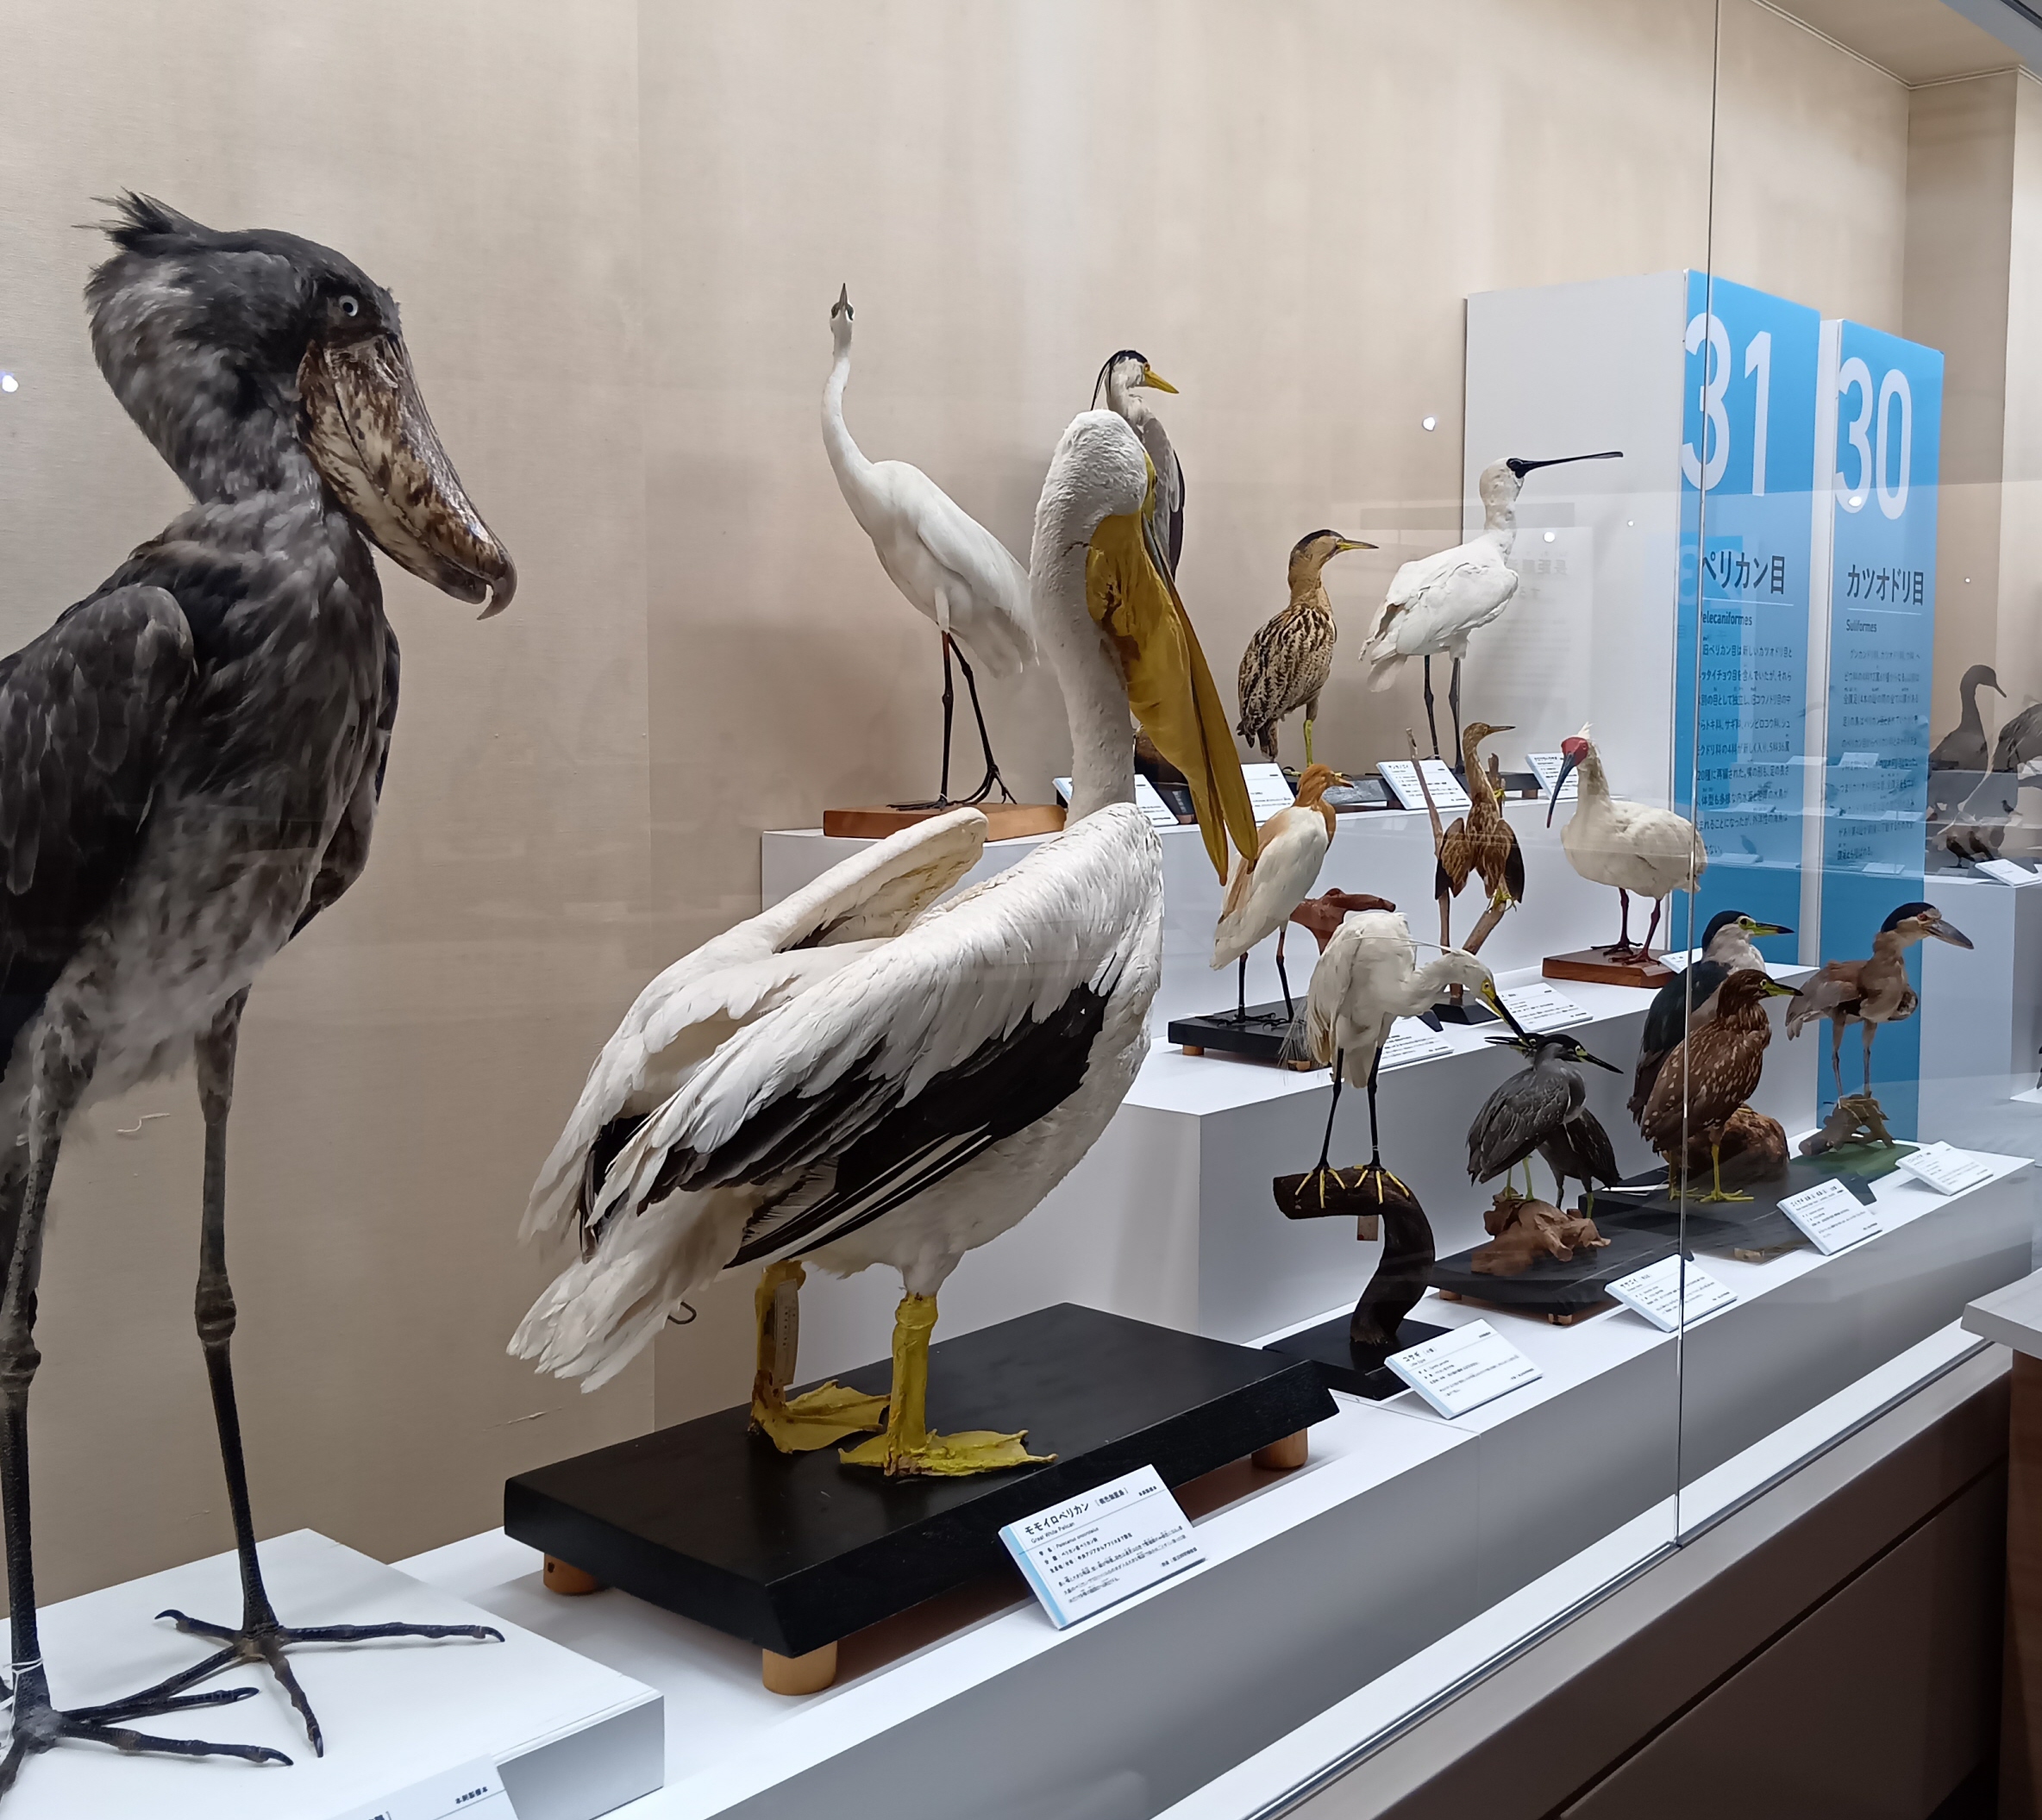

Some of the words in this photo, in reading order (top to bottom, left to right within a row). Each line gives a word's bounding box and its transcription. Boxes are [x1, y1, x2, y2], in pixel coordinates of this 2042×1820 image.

[1682, 313, 1771, 497] 31
[1835, 357, 1912, 520] 30
[1701, 550, 1785, 595] ペリカン目
[1846, 564, 1924, 606] カツオドリ目
[1701, 610, 1753, 626] elecaniformes
